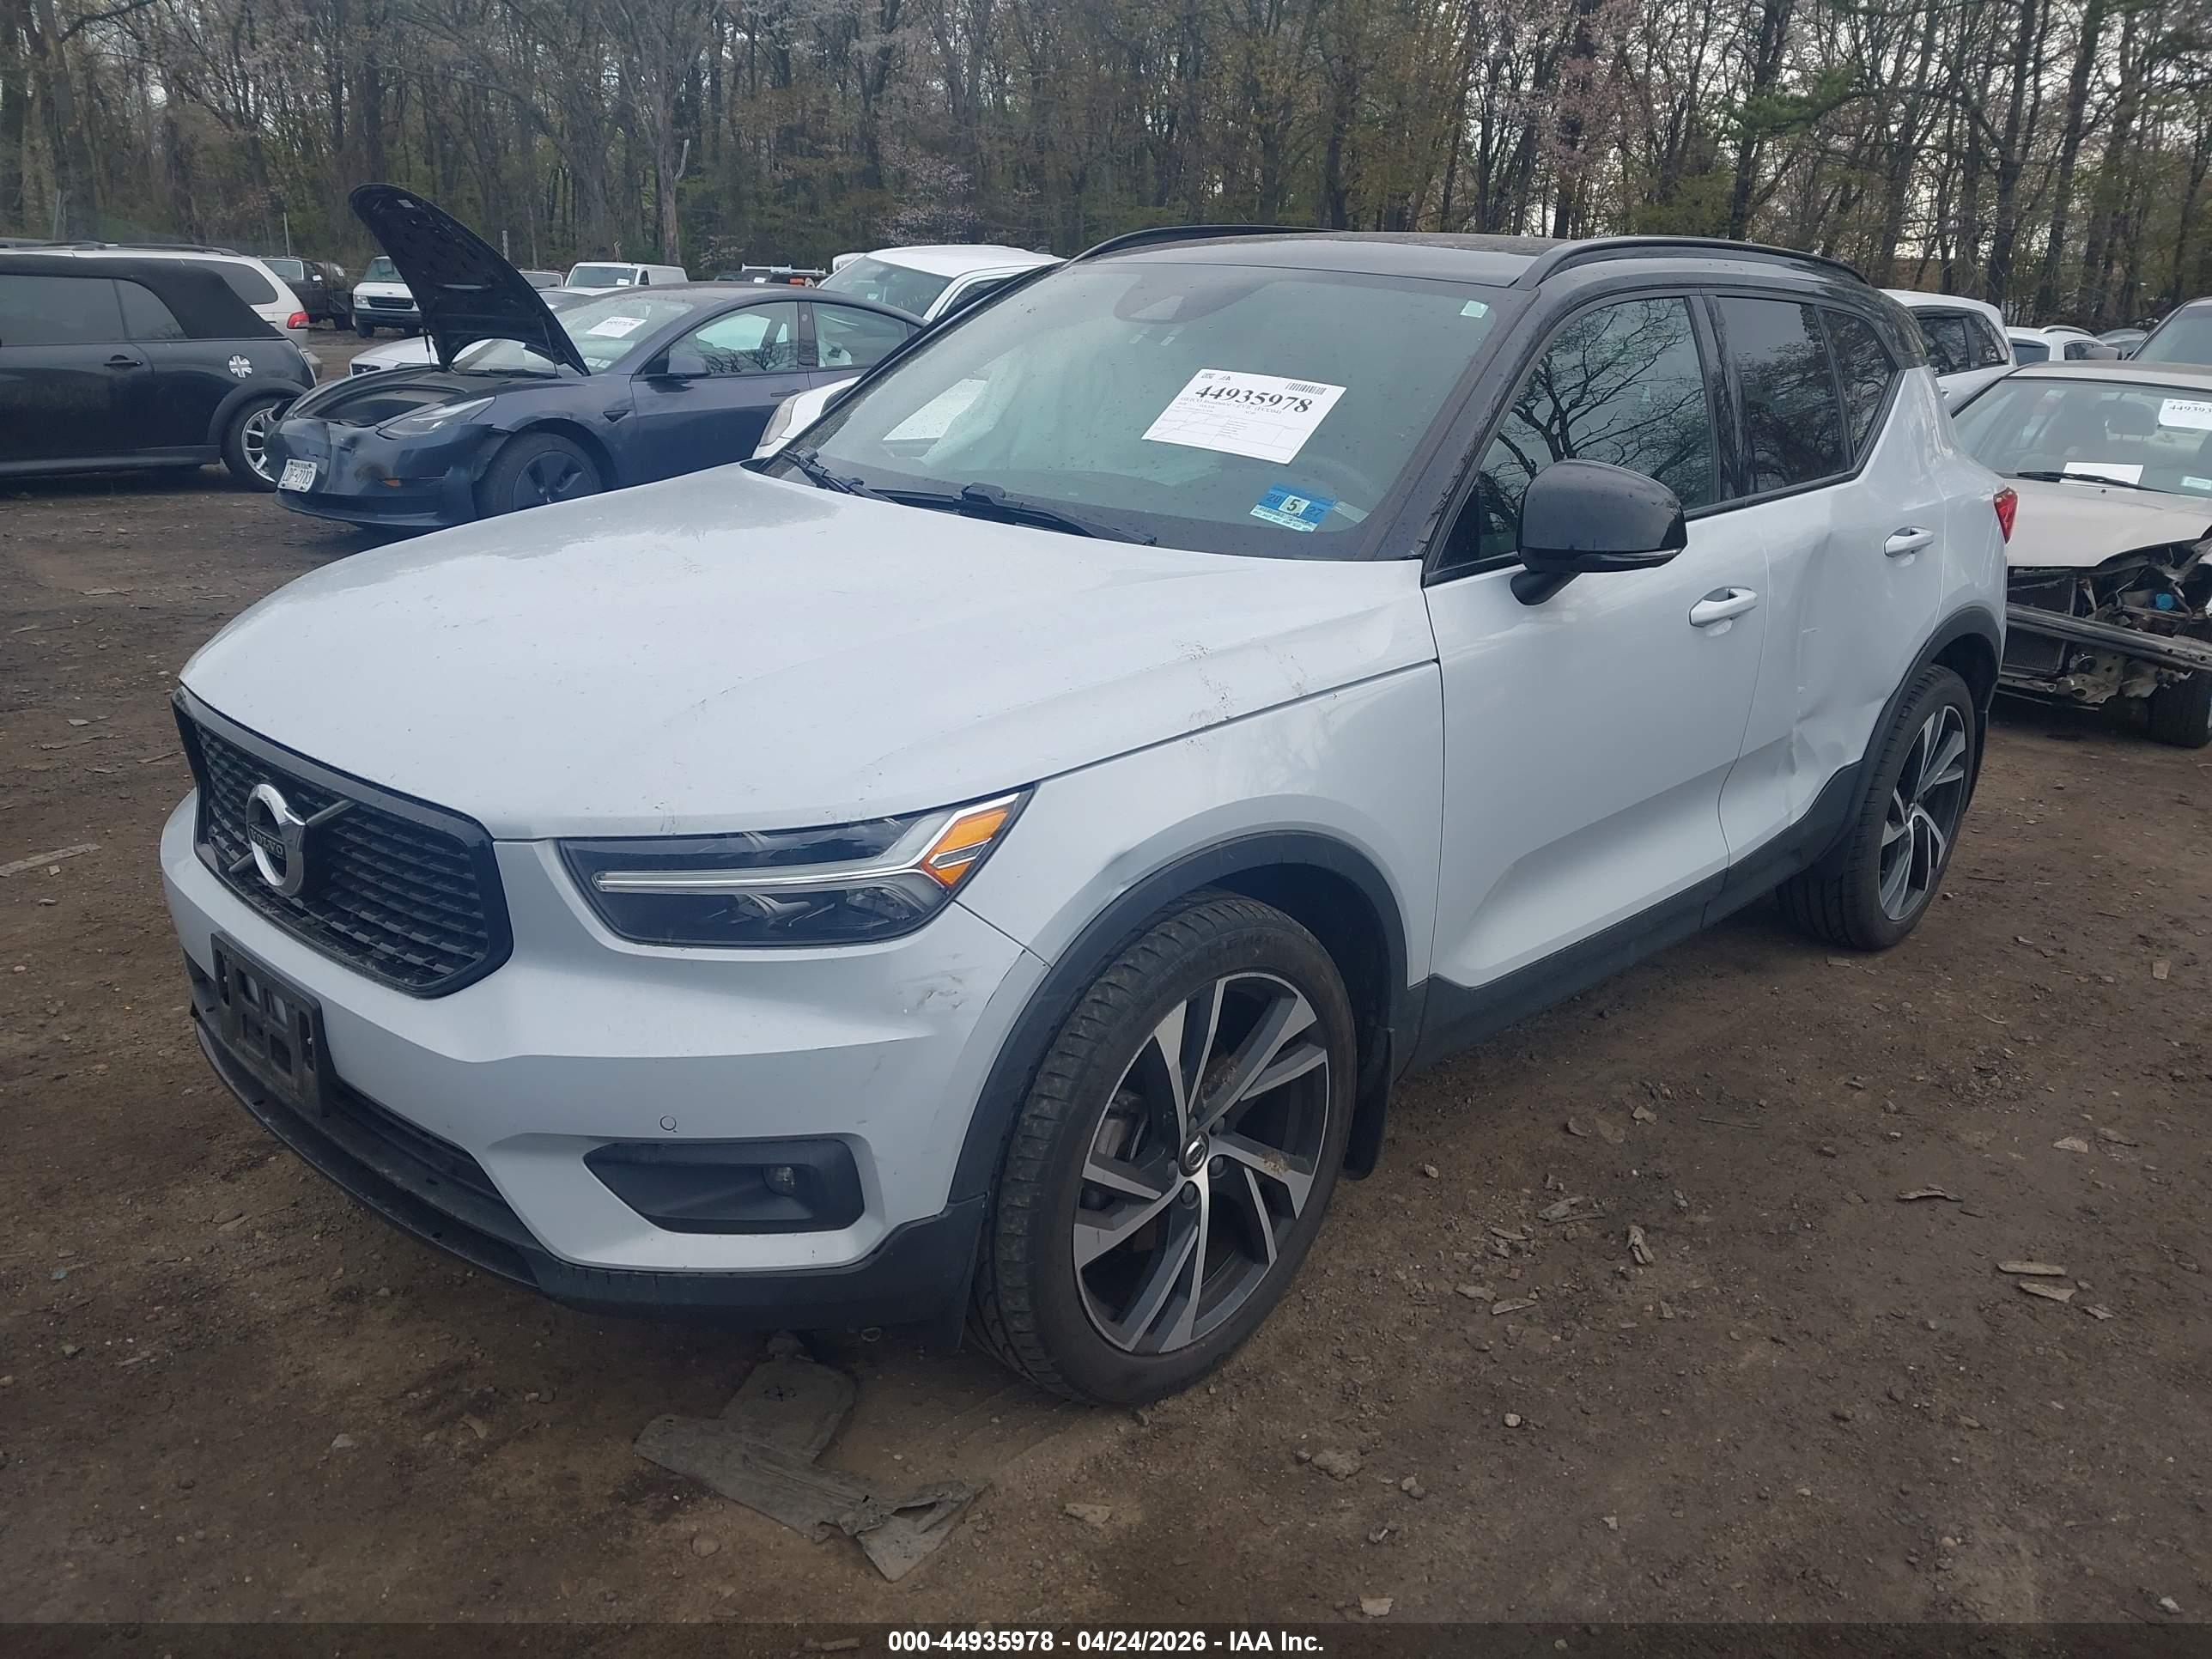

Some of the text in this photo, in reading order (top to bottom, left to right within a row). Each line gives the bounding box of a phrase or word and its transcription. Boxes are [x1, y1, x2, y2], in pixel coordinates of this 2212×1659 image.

[1194, 385, 1313, 413] 44935978
[1267, 494, 1282, 503] 20
[1287, 499, 1301, 511] 5
[250, 828, 283, 854] VOLVO
